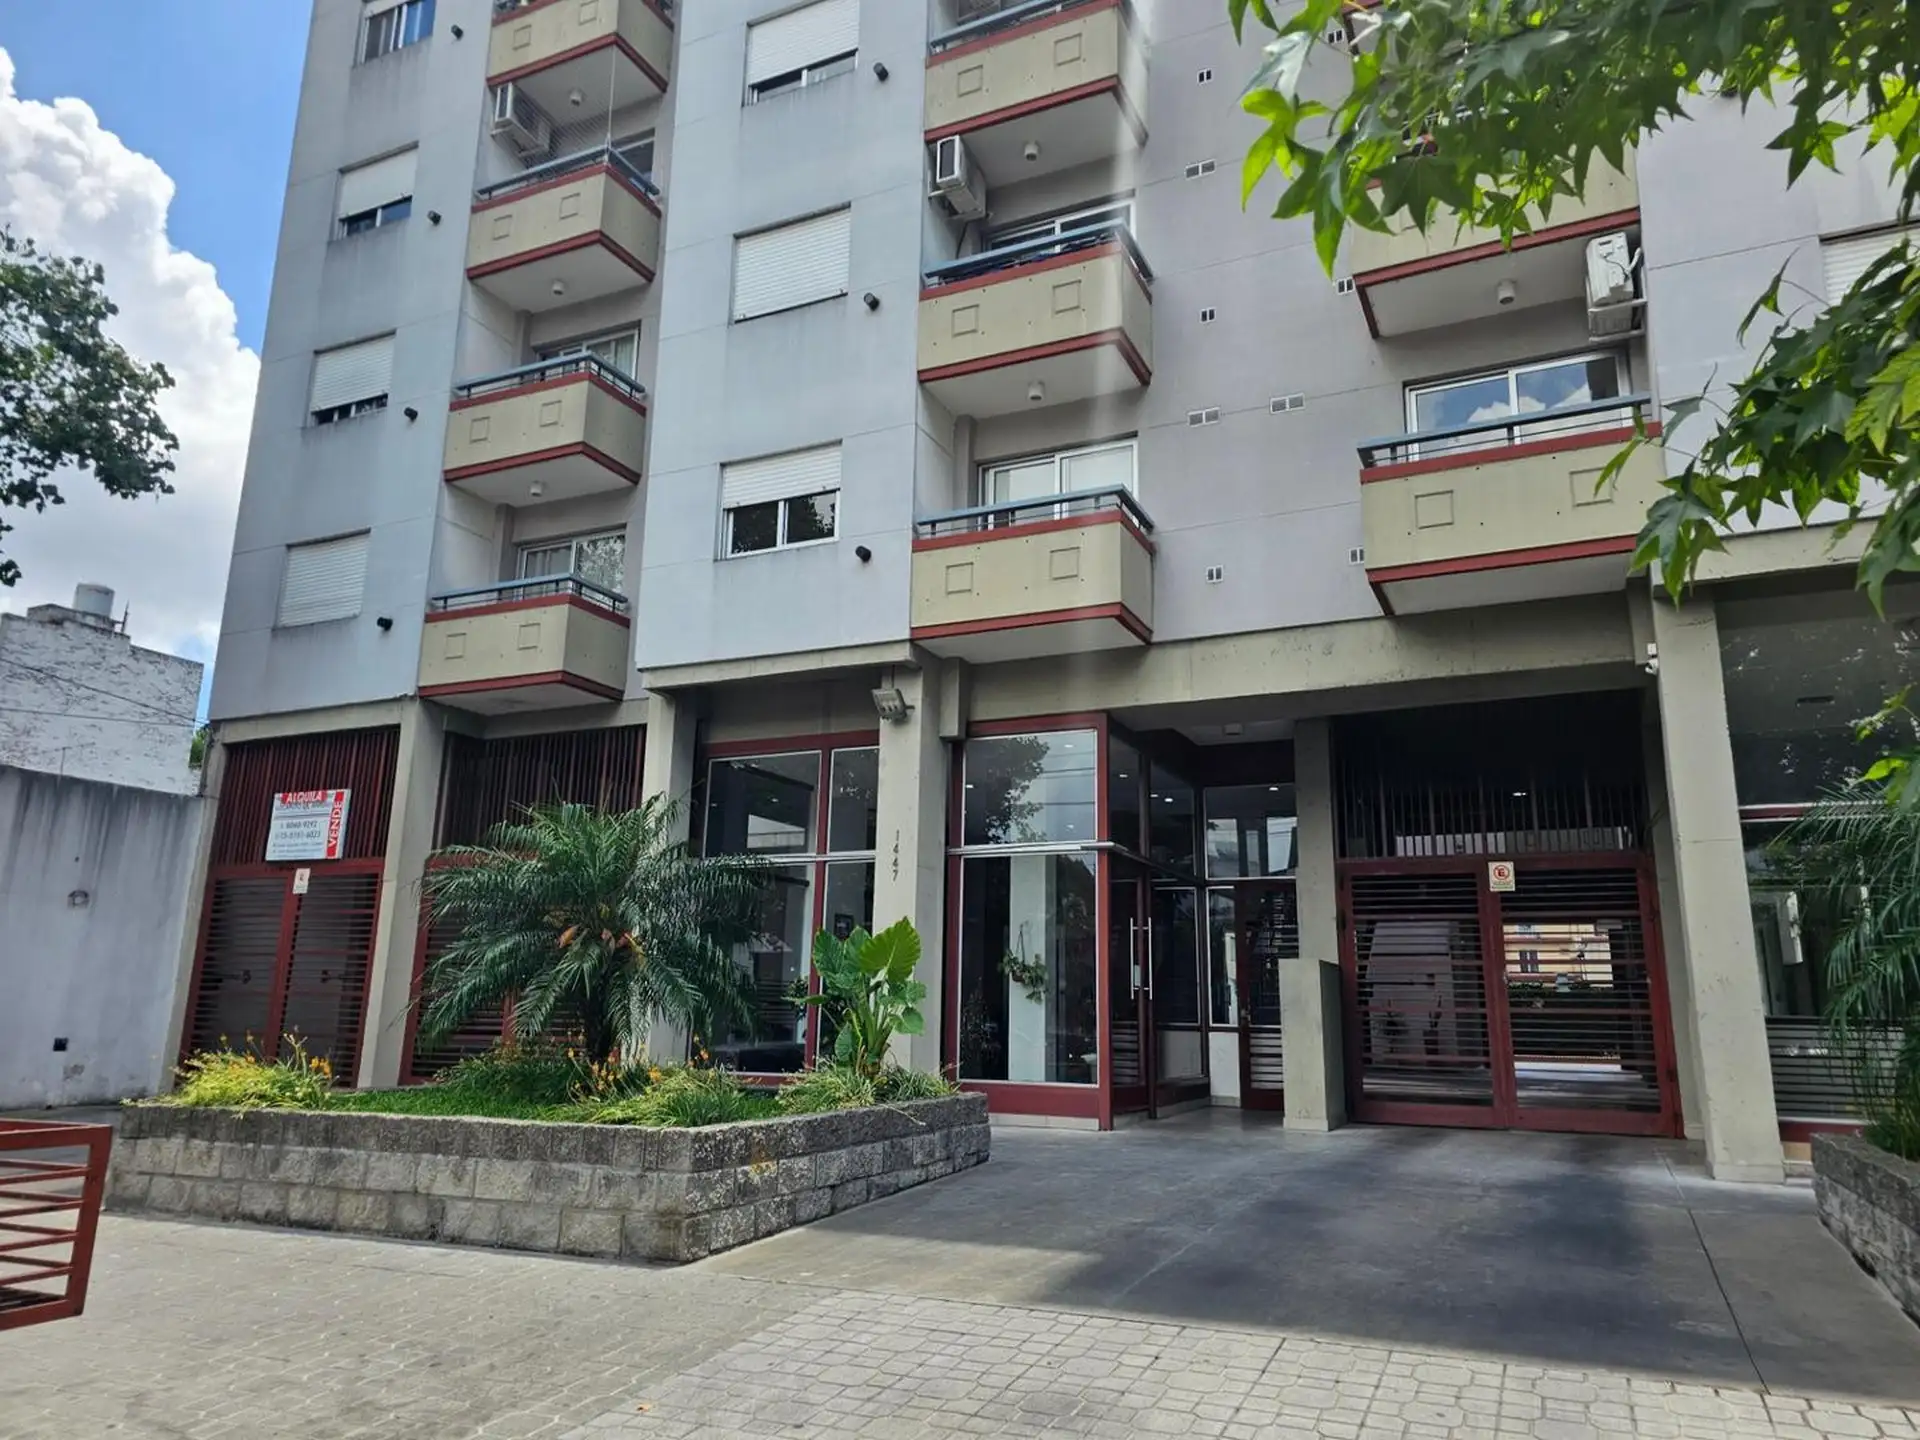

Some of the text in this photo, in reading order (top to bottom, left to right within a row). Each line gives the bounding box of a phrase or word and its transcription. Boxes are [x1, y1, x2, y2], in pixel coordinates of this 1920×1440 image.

[286, 791, 322, 803] ALQUILA
[328, 801, 343, 847] VENDE
[892, 829, 900, 882] 1447
